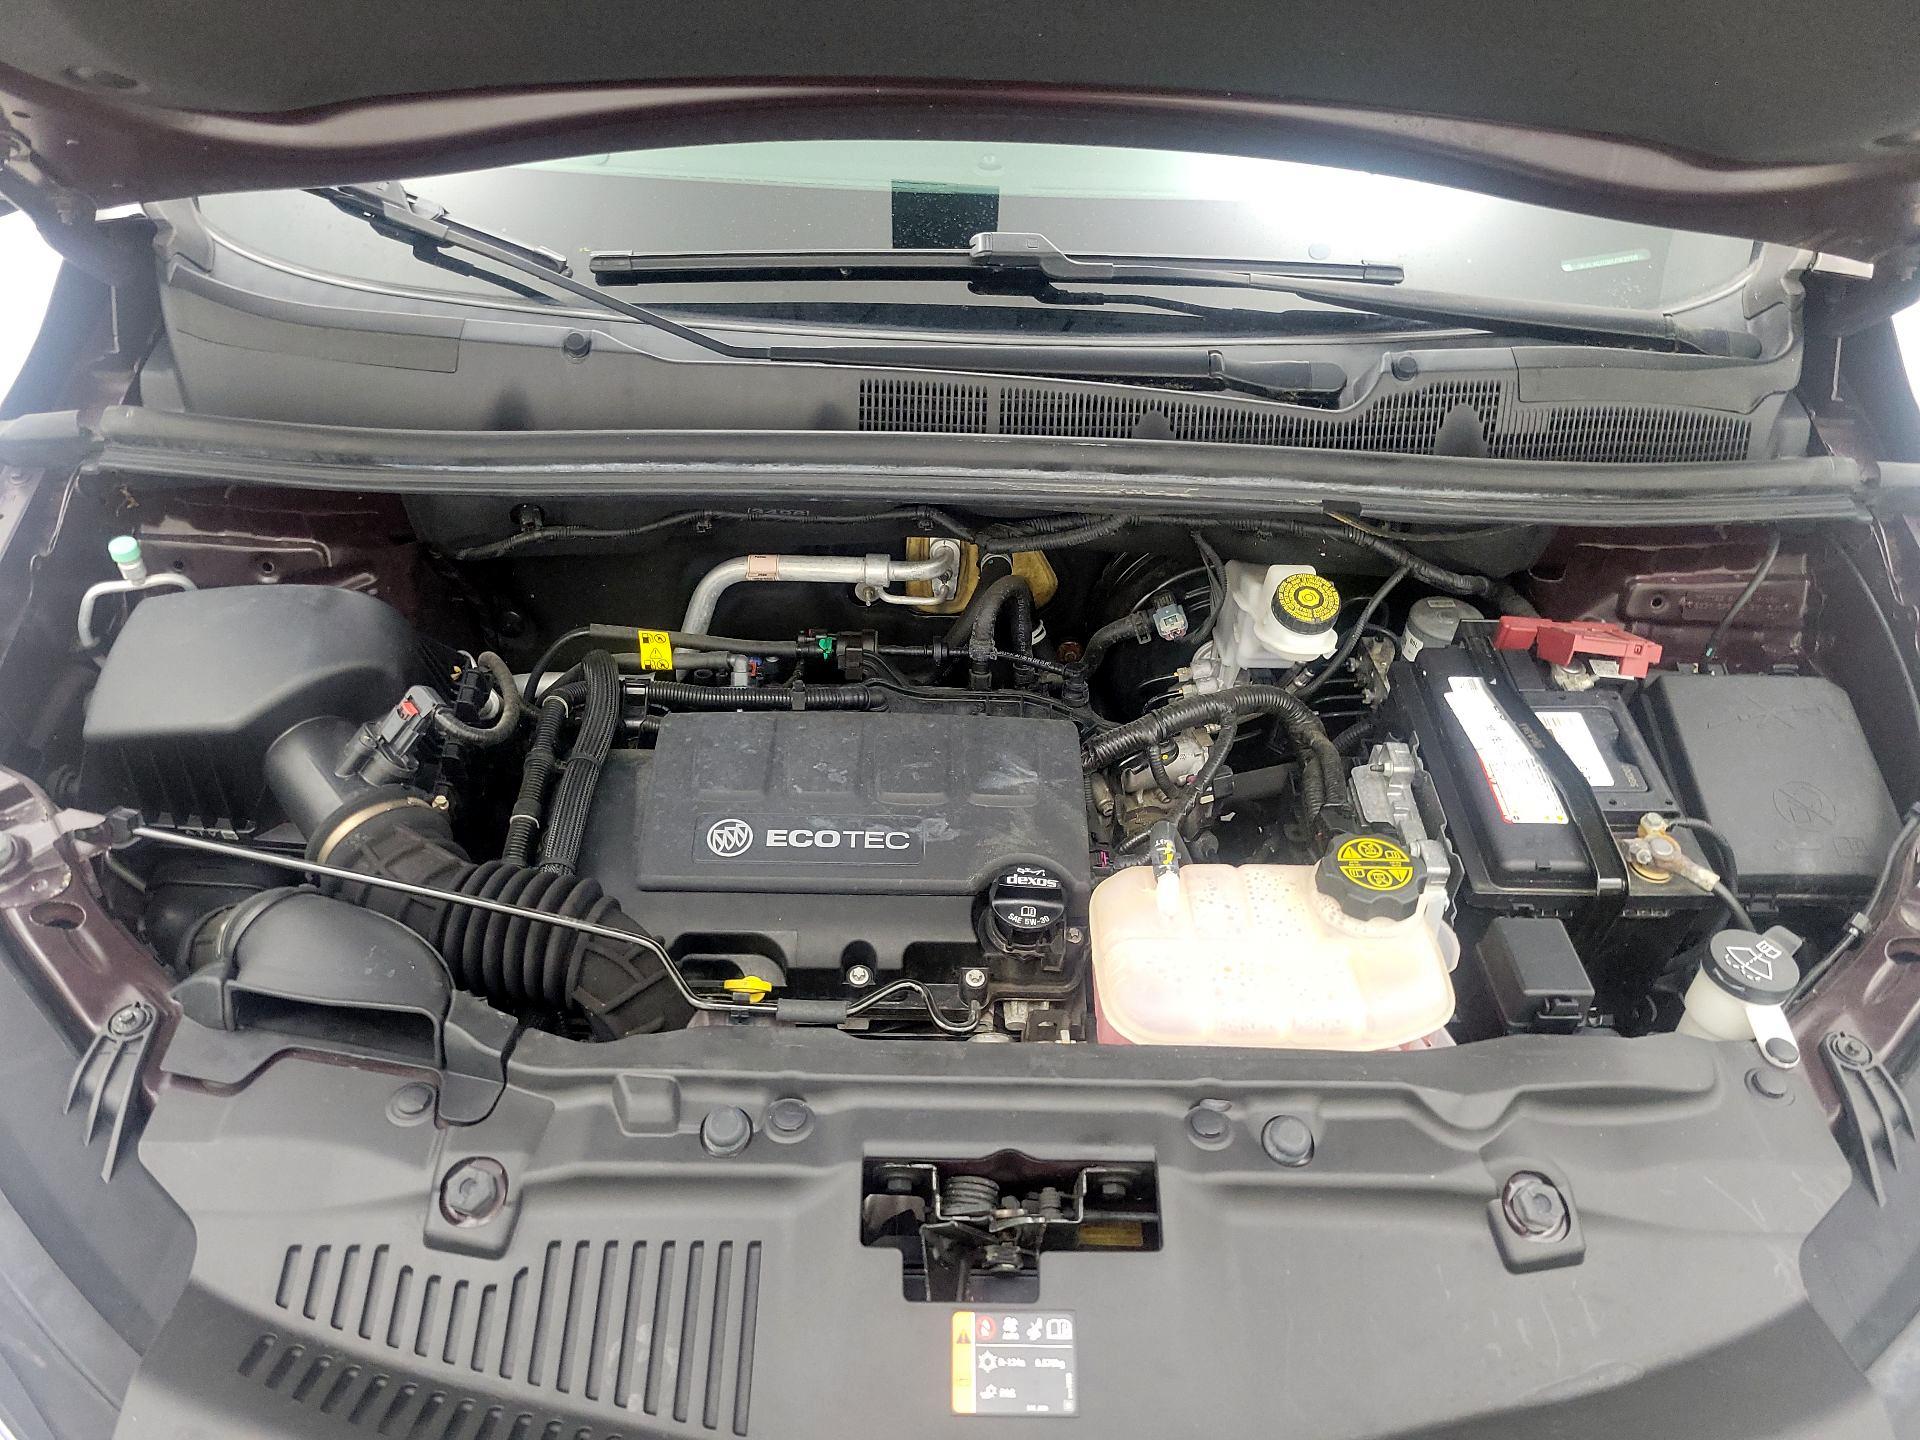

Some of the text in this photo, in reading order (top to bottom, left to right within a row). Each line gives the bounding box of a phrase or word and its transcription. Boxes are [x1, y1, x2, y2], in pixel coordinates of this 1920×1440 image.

[766, 829, 910, 849] ECOTEC
[1007, 873, 1059, 887] dexos
[1008, 912, 1023, 924] SAE
